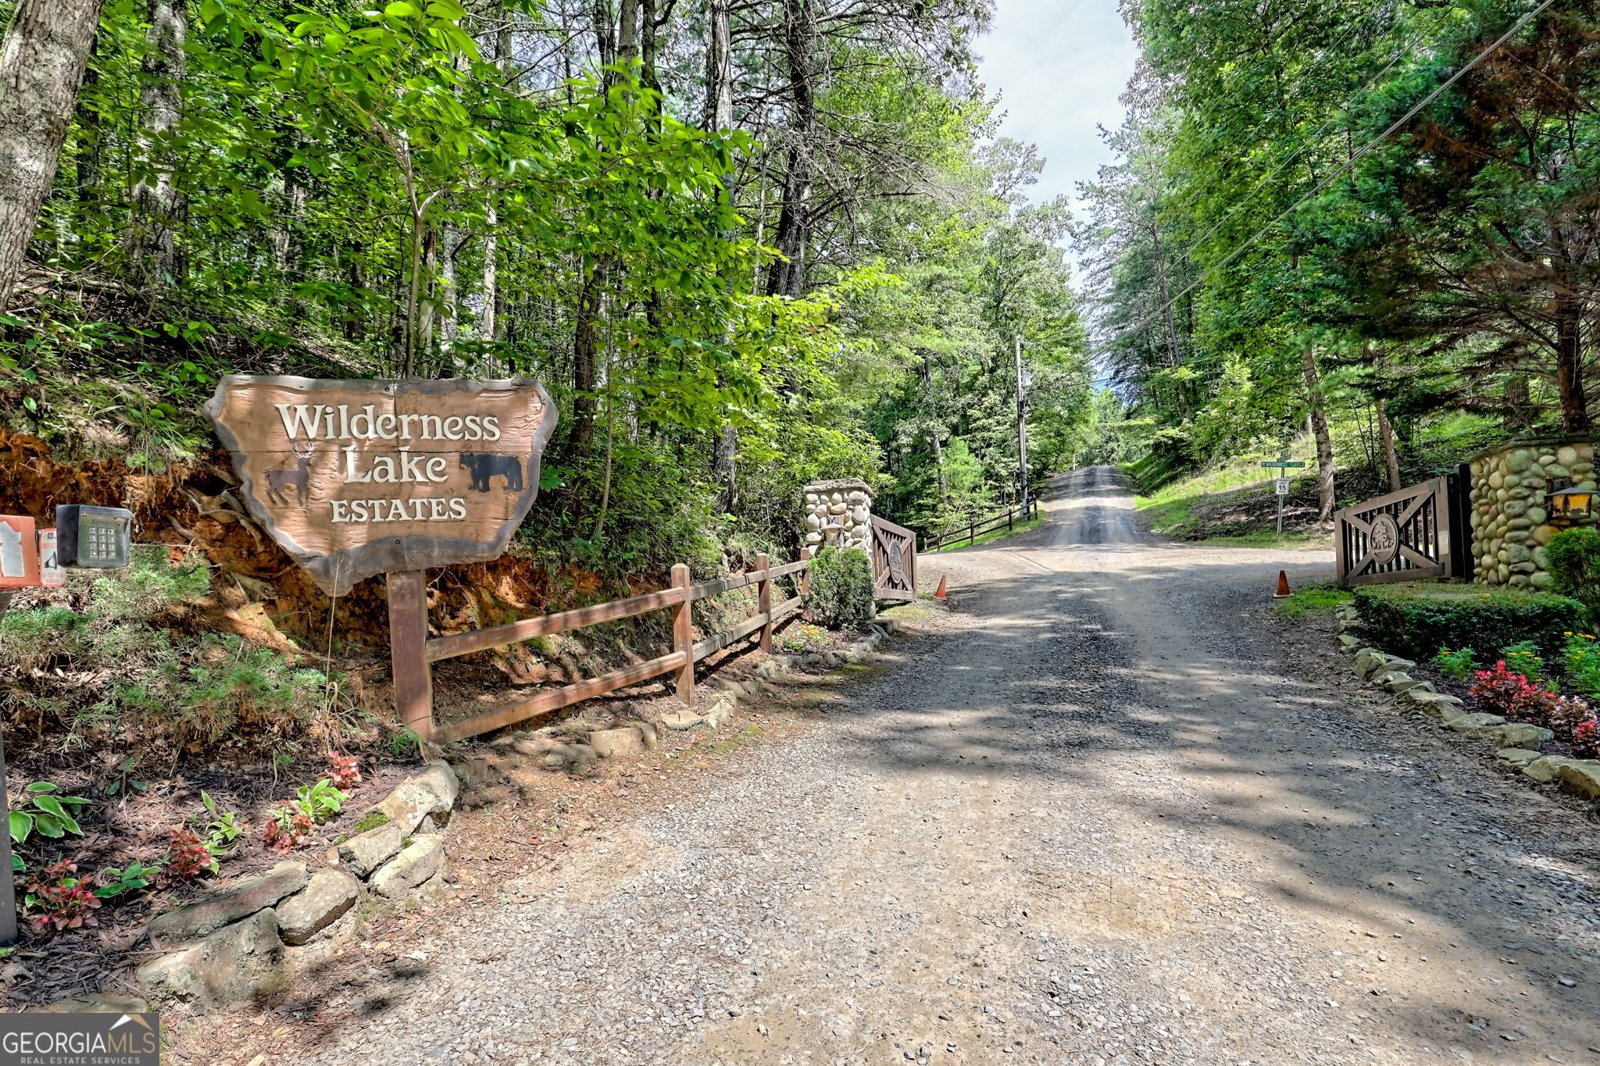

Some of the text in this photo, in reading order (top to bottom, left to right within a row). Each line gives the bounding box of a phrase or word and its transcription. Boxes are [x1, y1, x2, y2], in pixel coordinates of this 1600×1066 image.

[274, 403, 502, 442] Wilderness
[341, 445, 449, 484] Lake
[330, 496, 467, 523] ESTATES
